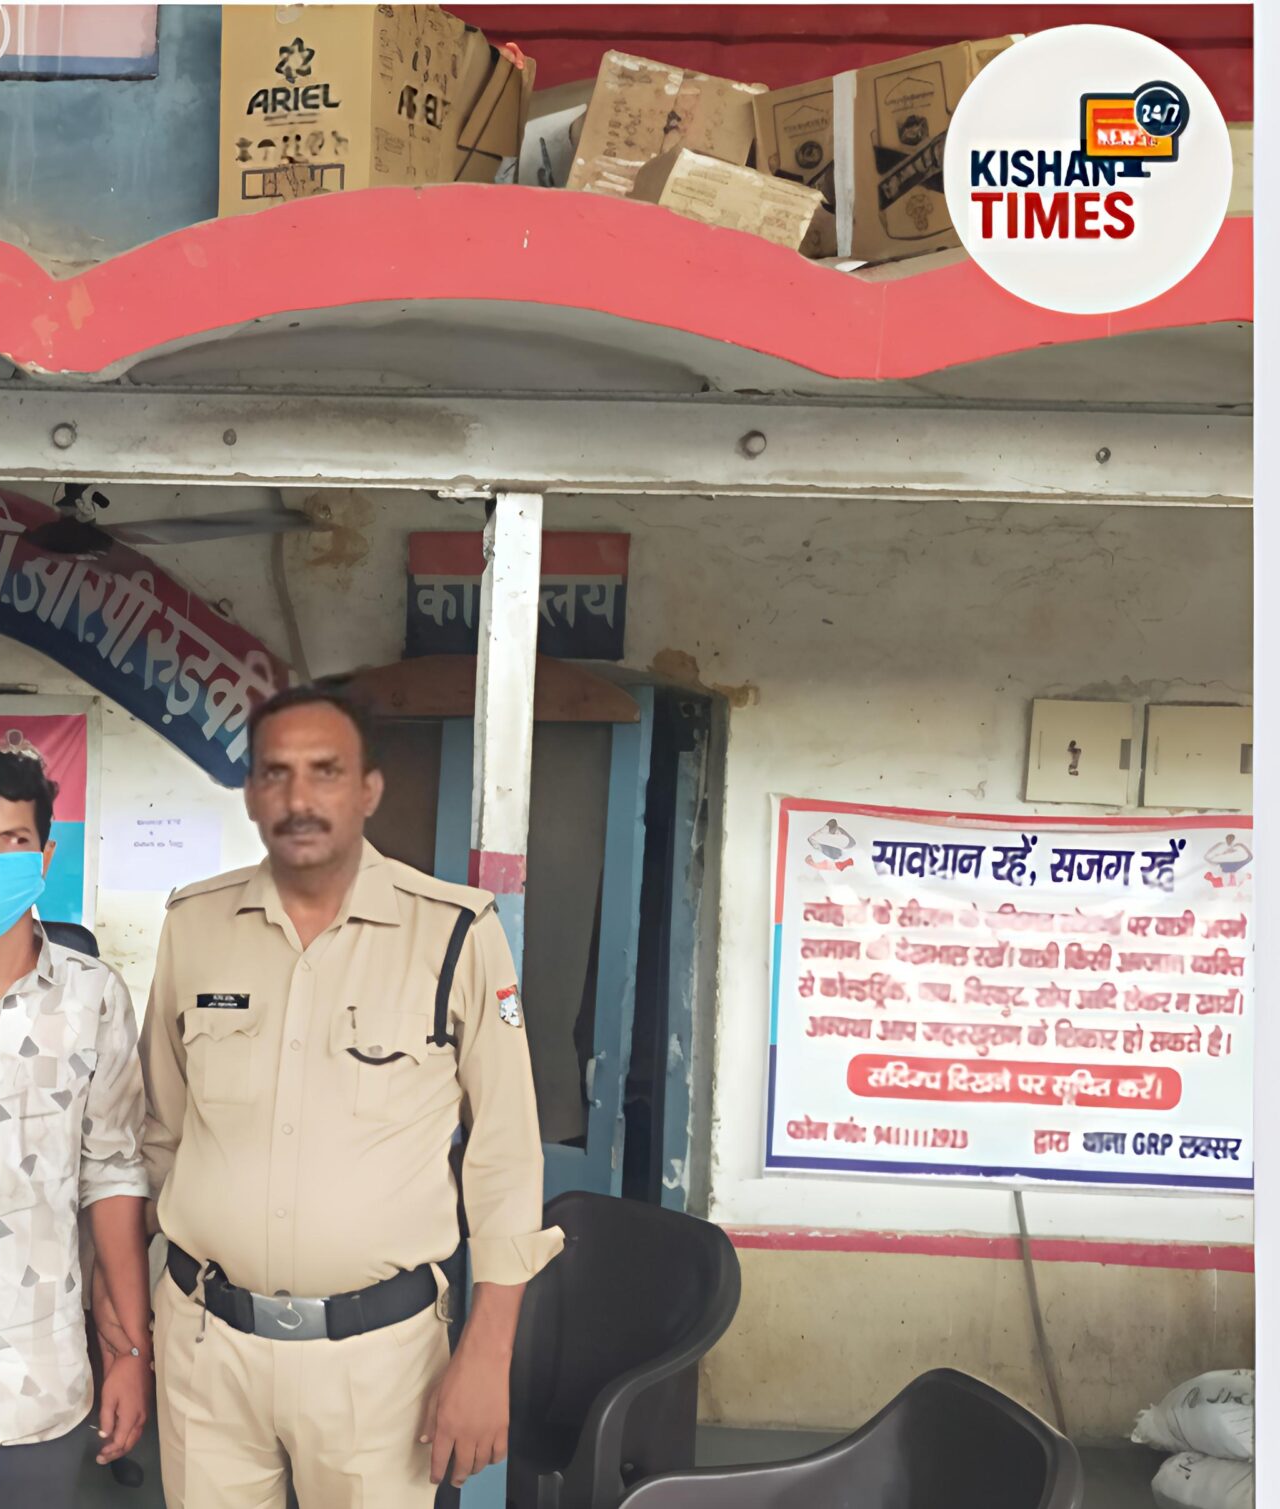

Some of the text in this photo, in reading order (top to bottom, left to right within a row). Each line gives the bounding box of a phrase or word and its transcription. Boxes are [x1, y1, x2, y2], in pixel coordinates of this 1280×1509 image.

[246, 84, 340, 115] ARIEL
[872, 840, 986, 879] सावधान
[1050, 848, 1135, 886] सजग
[1018, 1074, 1045, 1095] पर
[1132, 1132, 1173, 1156] GRP
[1179, 1135, 1243, 1161] लक्सर
